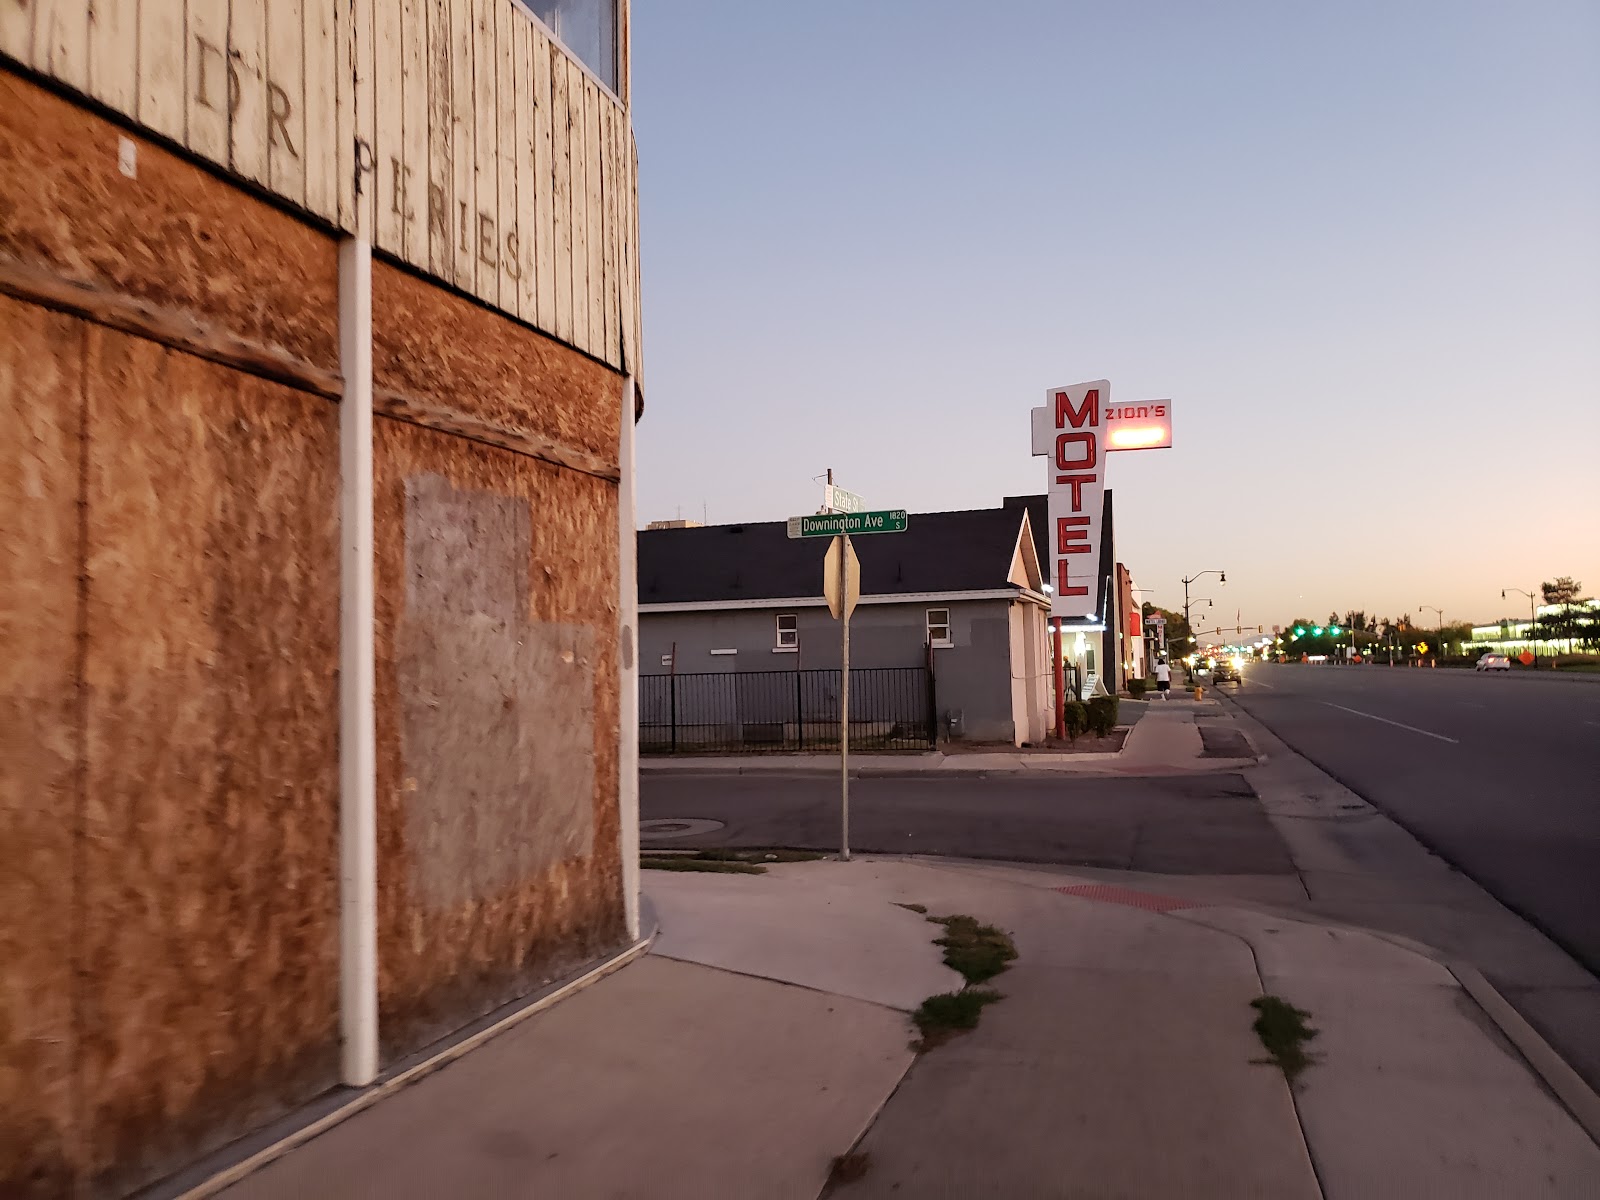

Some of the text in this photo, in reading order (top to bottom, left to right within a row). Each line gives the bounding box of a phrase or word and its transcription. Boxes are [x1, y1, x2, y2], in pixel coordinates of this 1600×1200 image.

[834, 490, 852, 510] State
[1055, 389, 1099, 597] MOTEL
[803, 516, 860, 534] Downington
[864, 513, 883, 528] Ave
[889, 511, 906, 520] 1820
[895, 521, 901, 530] S
